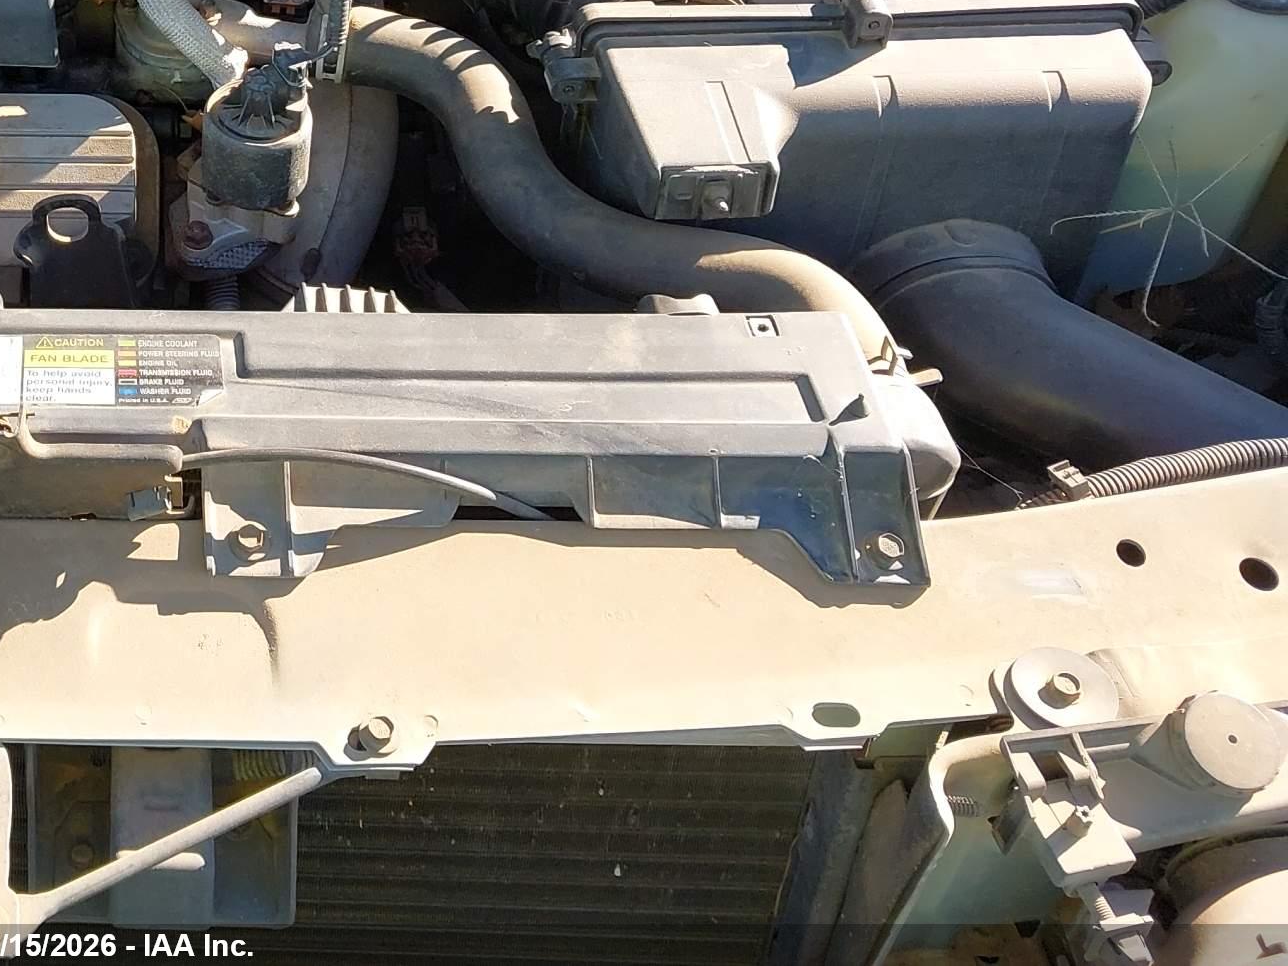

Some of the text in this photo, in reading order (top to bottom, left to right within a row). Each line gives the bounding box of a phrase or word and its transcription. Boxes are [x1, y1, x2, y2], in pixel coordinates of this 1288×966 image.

[54, 338, 104, 347] CAUTION
[165, 339, 197, 347] COOLANT
[30, 354, 109, 363] FAN BLADE
[43, 370, 67, 378] help
[26, 378, 75, 386] personal
